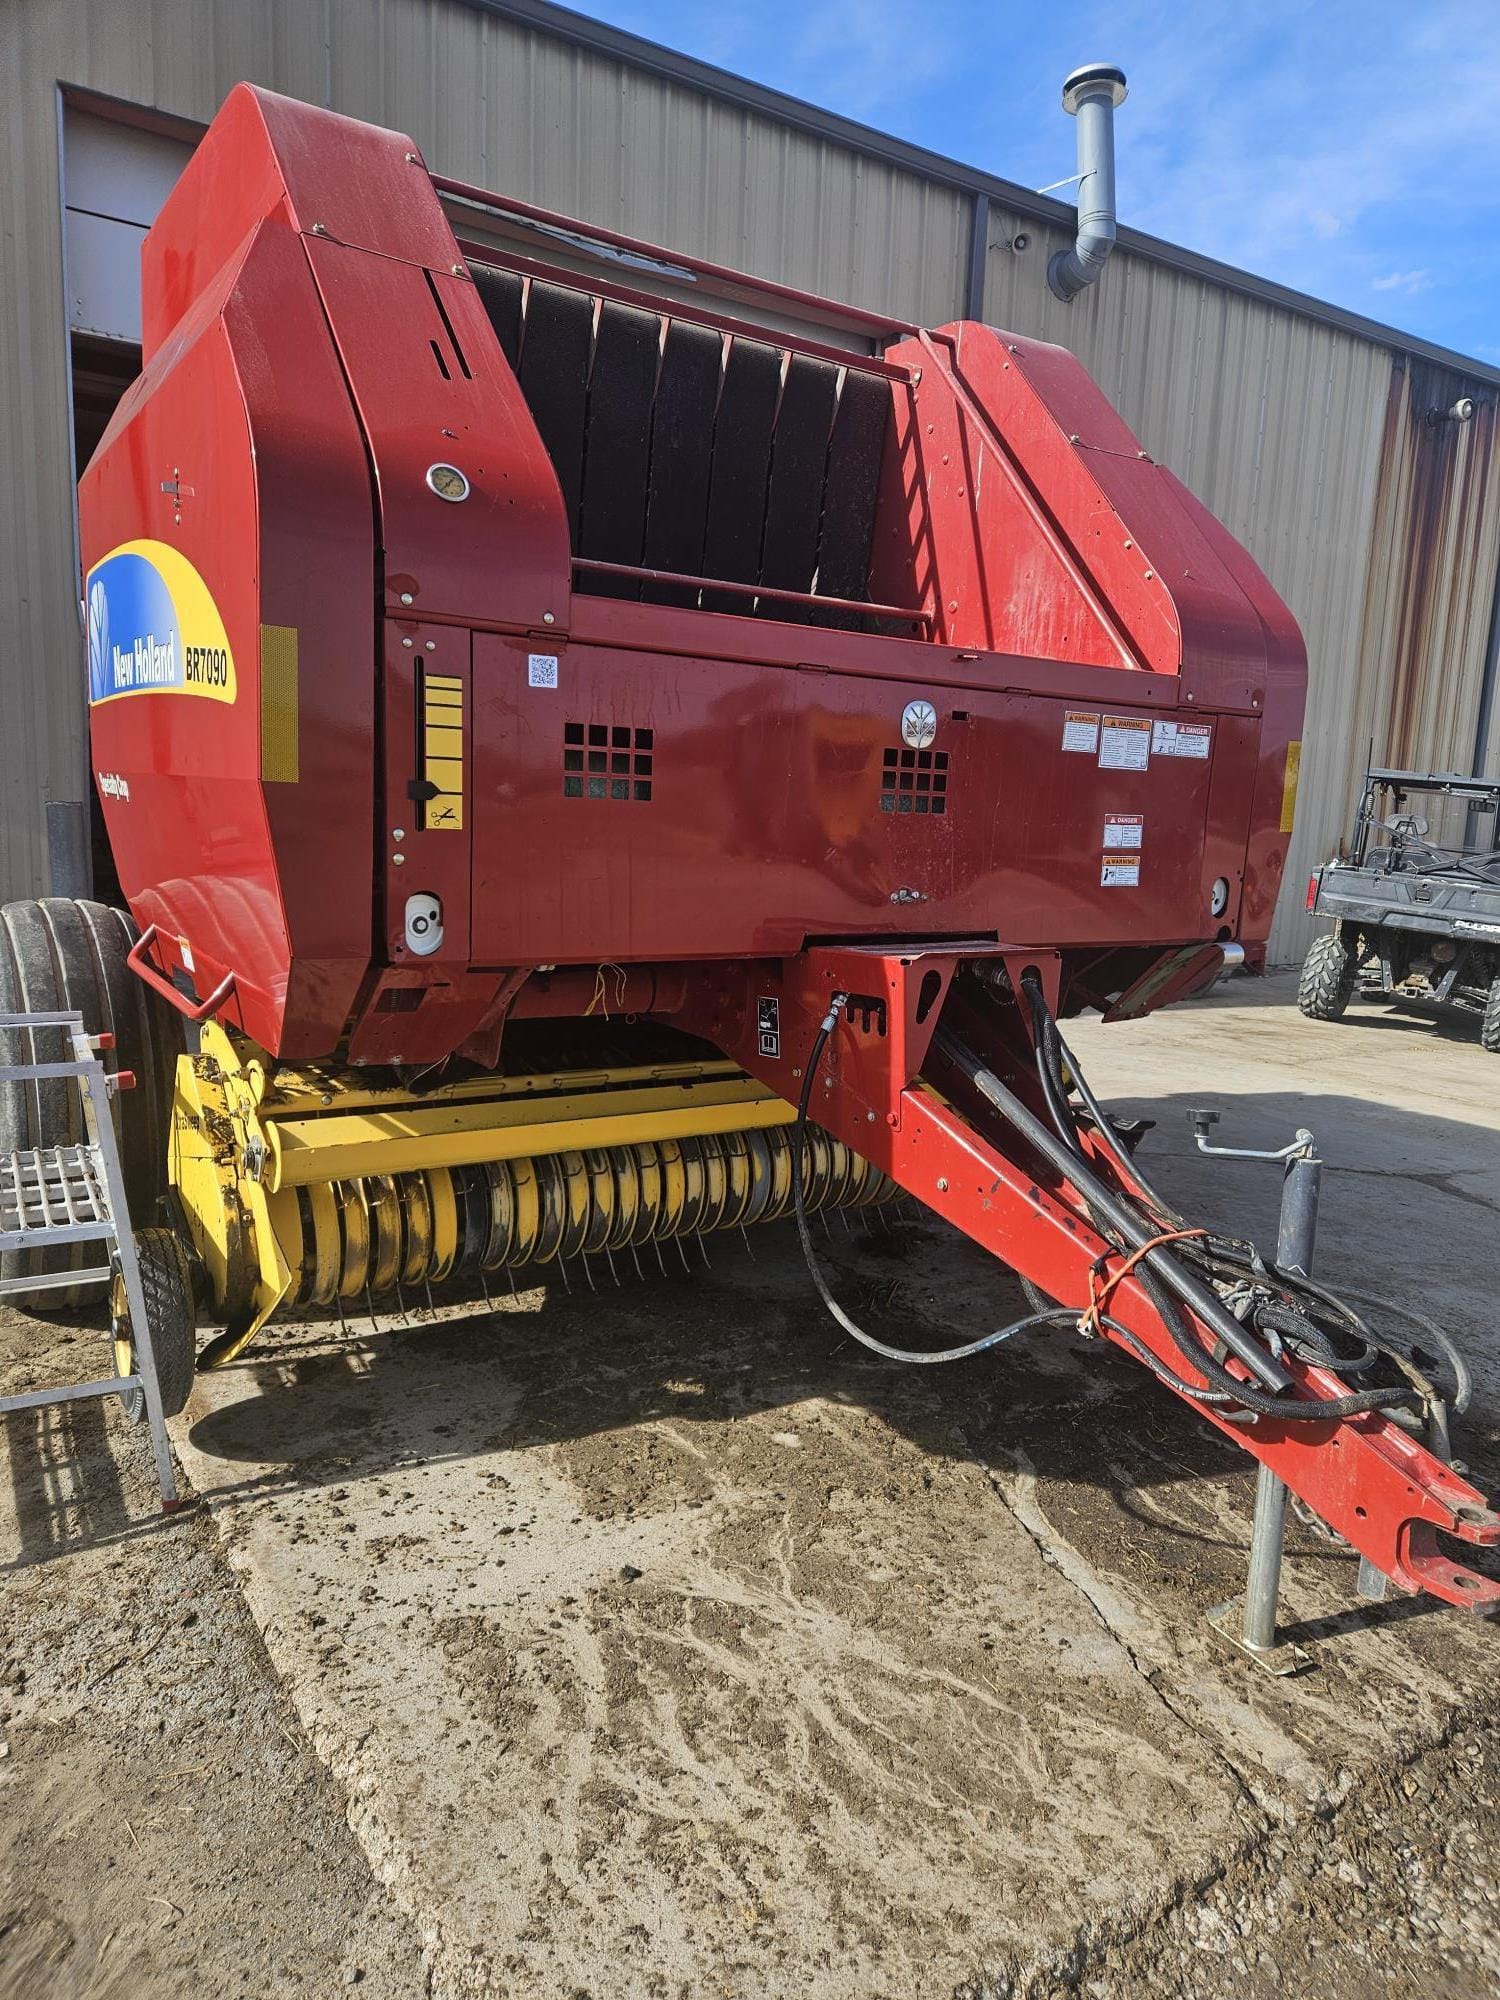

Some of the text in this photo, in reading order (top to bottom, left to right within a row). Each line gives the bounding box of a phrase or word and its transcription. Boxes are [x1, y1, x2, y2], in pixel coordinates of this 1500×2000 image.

[113, 630, 175, 688] New Holland
[186, 647, 227, 687] BR7090
[1118, 720, 1144, 728] WARNING
[1185, 727, 1208, 735] DANGER
